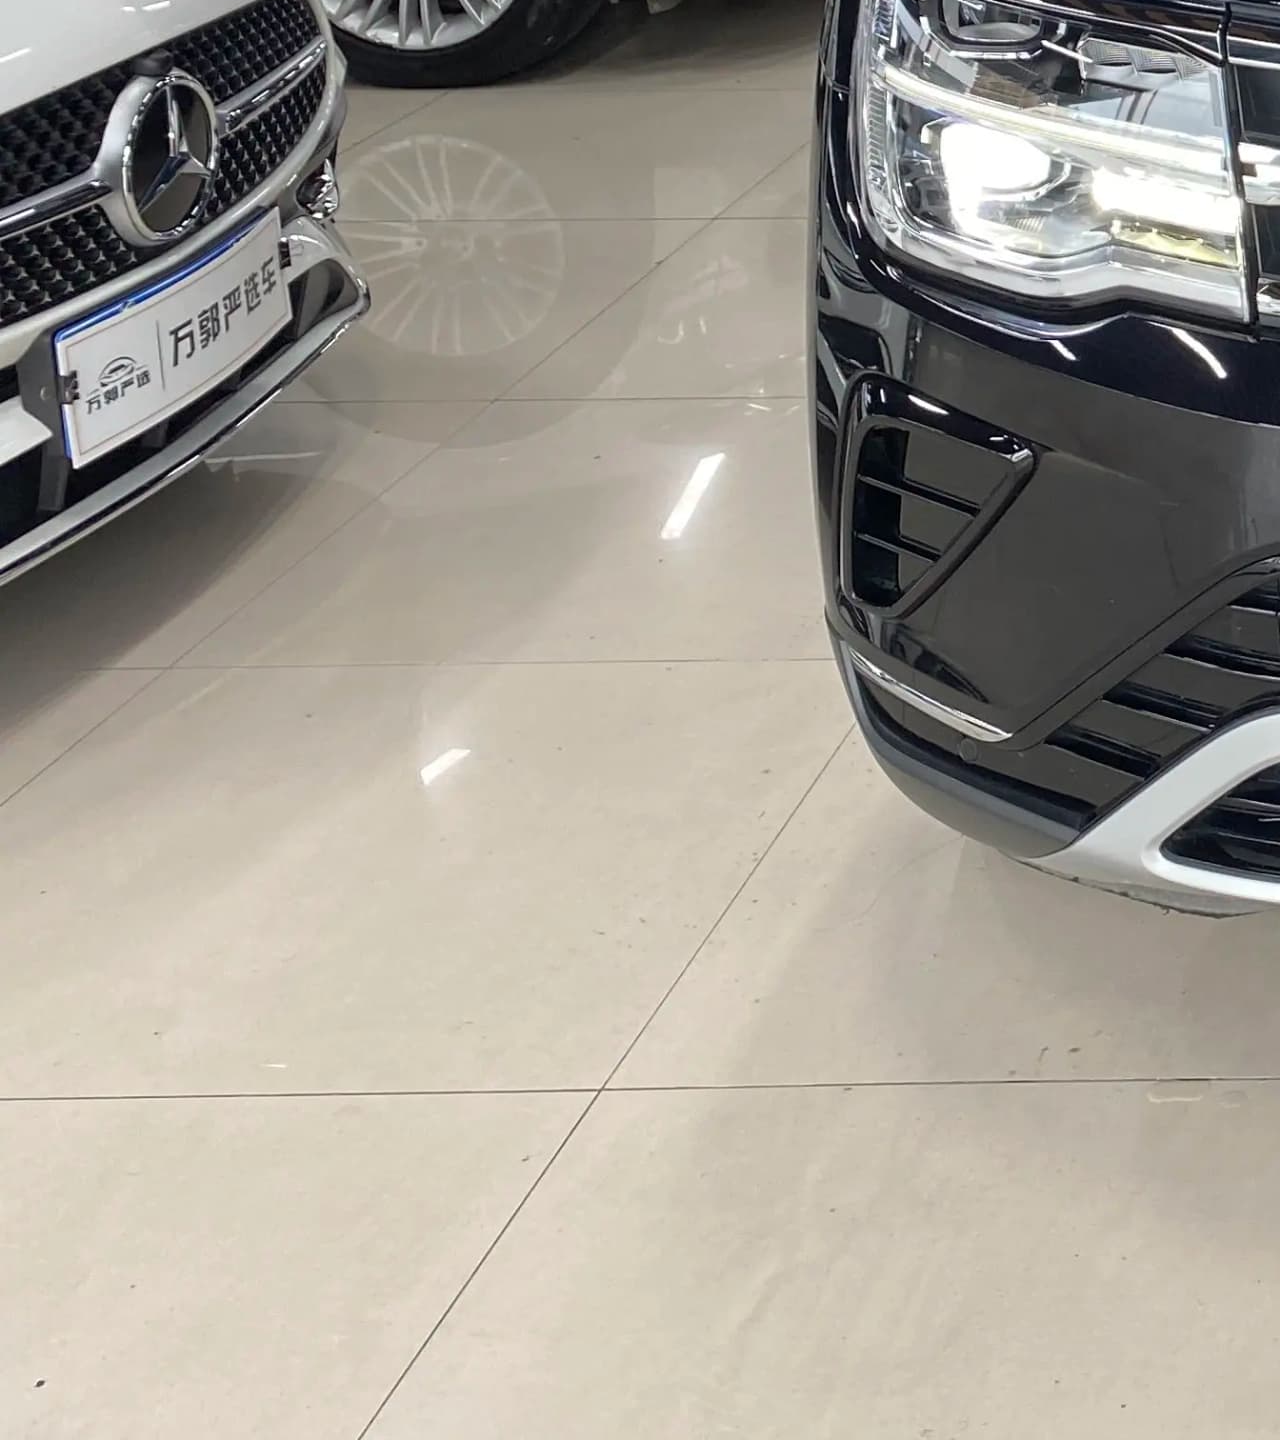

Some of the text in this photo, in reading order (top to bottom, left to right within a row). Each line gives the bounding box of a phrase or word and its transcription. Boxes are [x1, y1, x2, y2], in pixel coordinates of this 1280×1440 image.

[169, 256, 278, 367] 万郭严选车
[85, 370, 152, 415] 万郭严选
